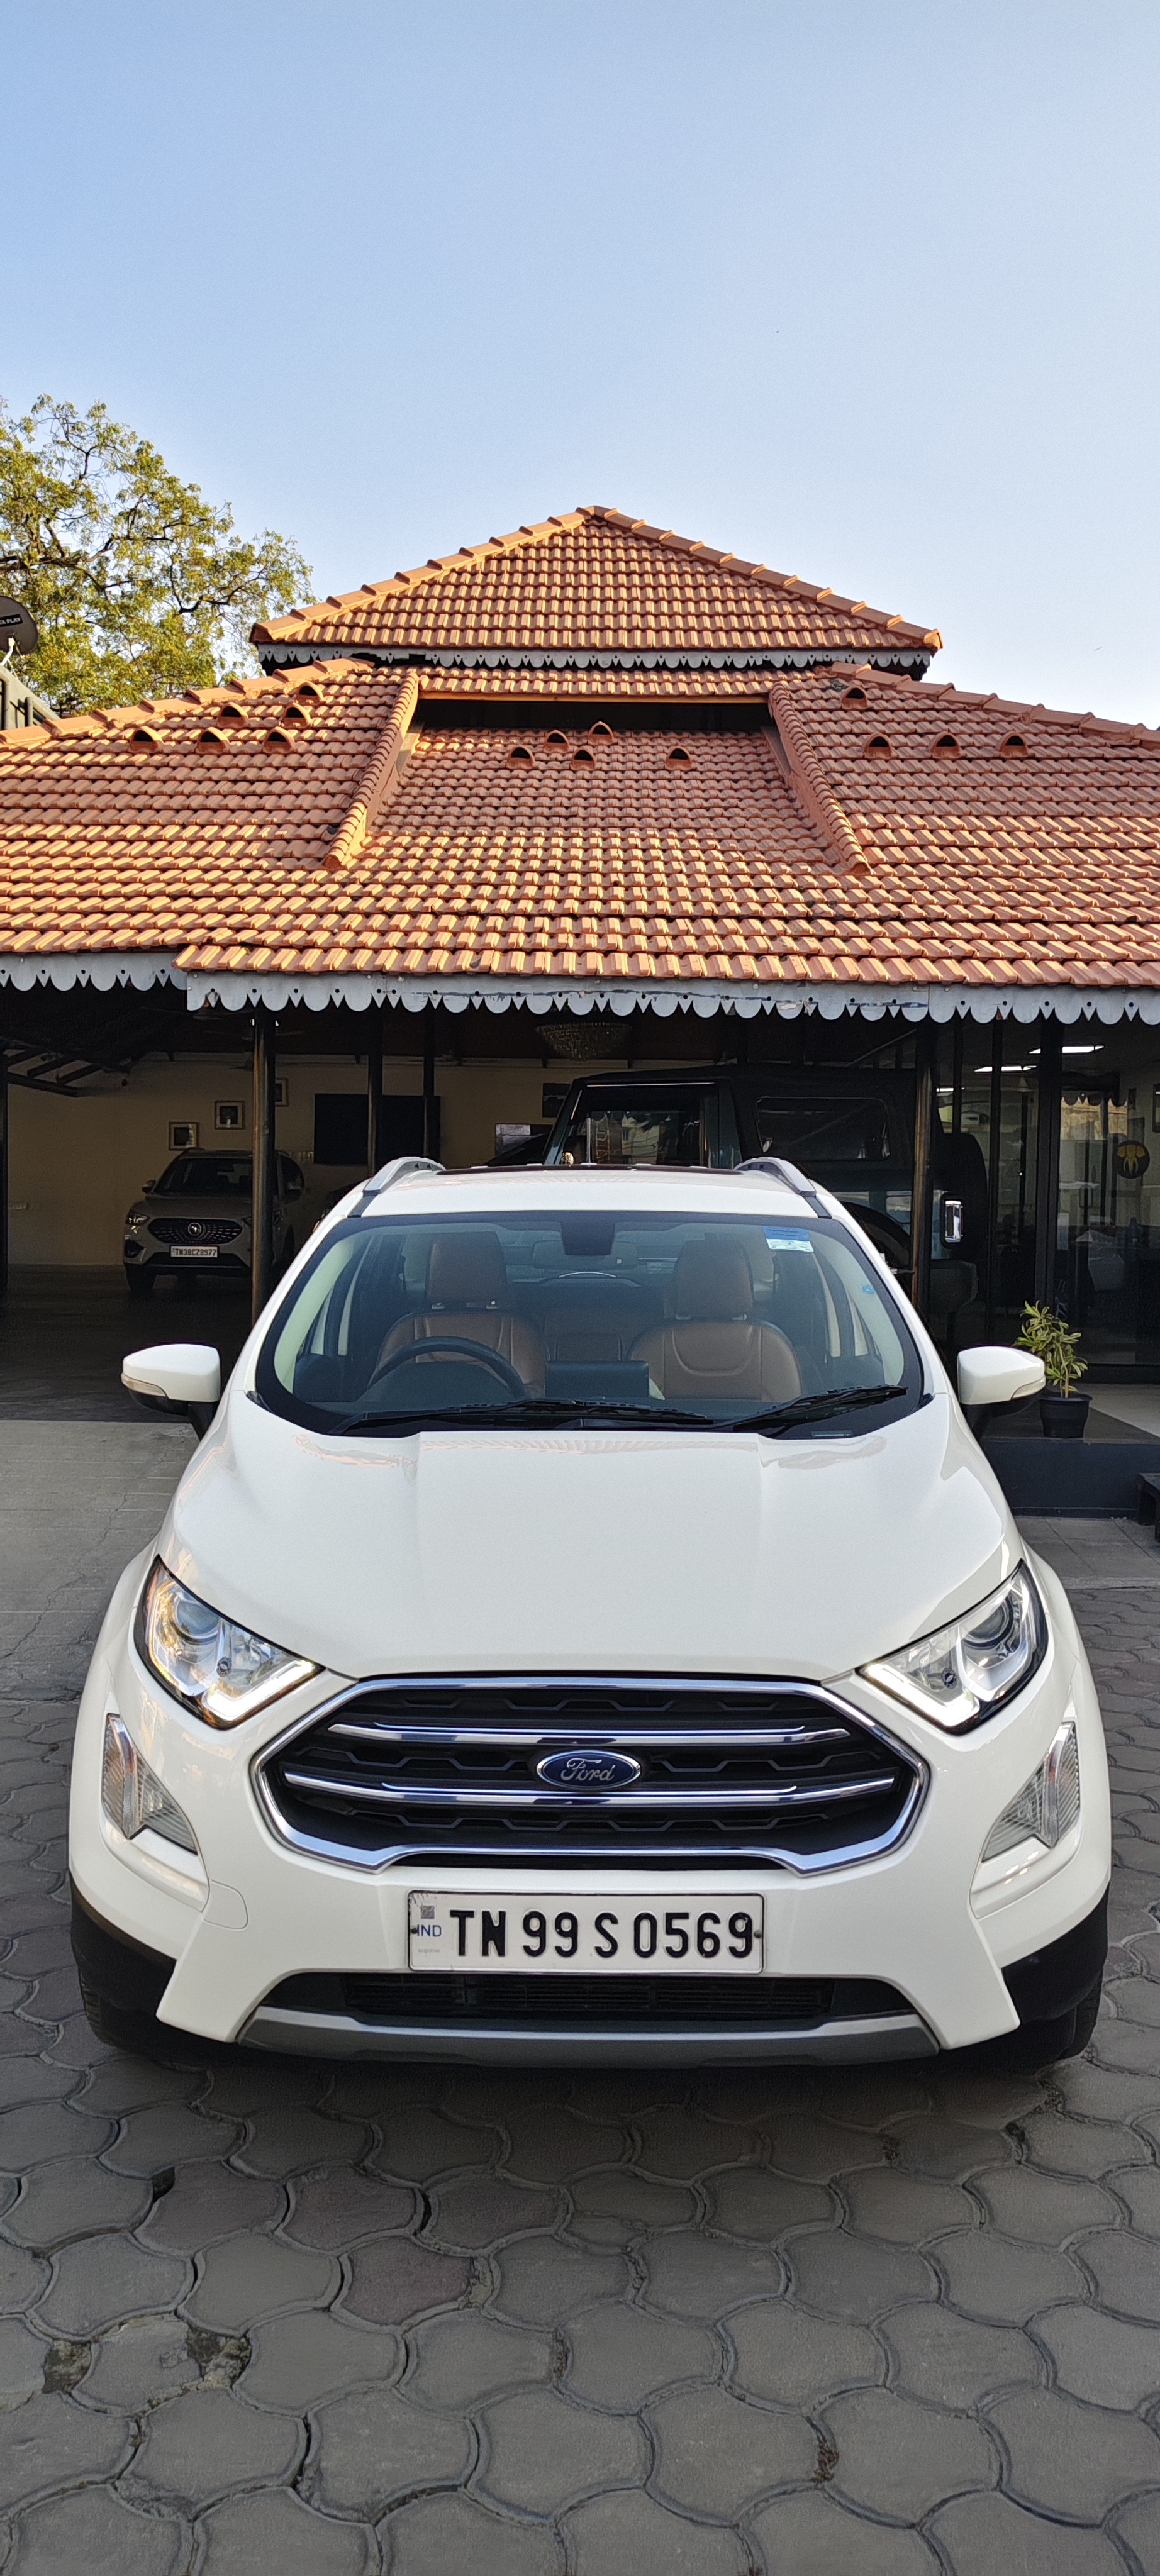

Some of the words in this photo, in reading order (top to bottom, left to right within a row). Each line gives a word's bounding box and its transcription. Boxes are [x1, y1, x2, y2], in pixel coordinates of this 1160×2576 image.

[560, 1758, 616, 1781] Ford
[416, 1924, 442, 1937] IND
[450, 1909, 506, 1957] TN
[522, 1910, 578, 1958] 99
[594, 1912, 618, 1958] S
[633, 1911, 753, 1958] 0569
